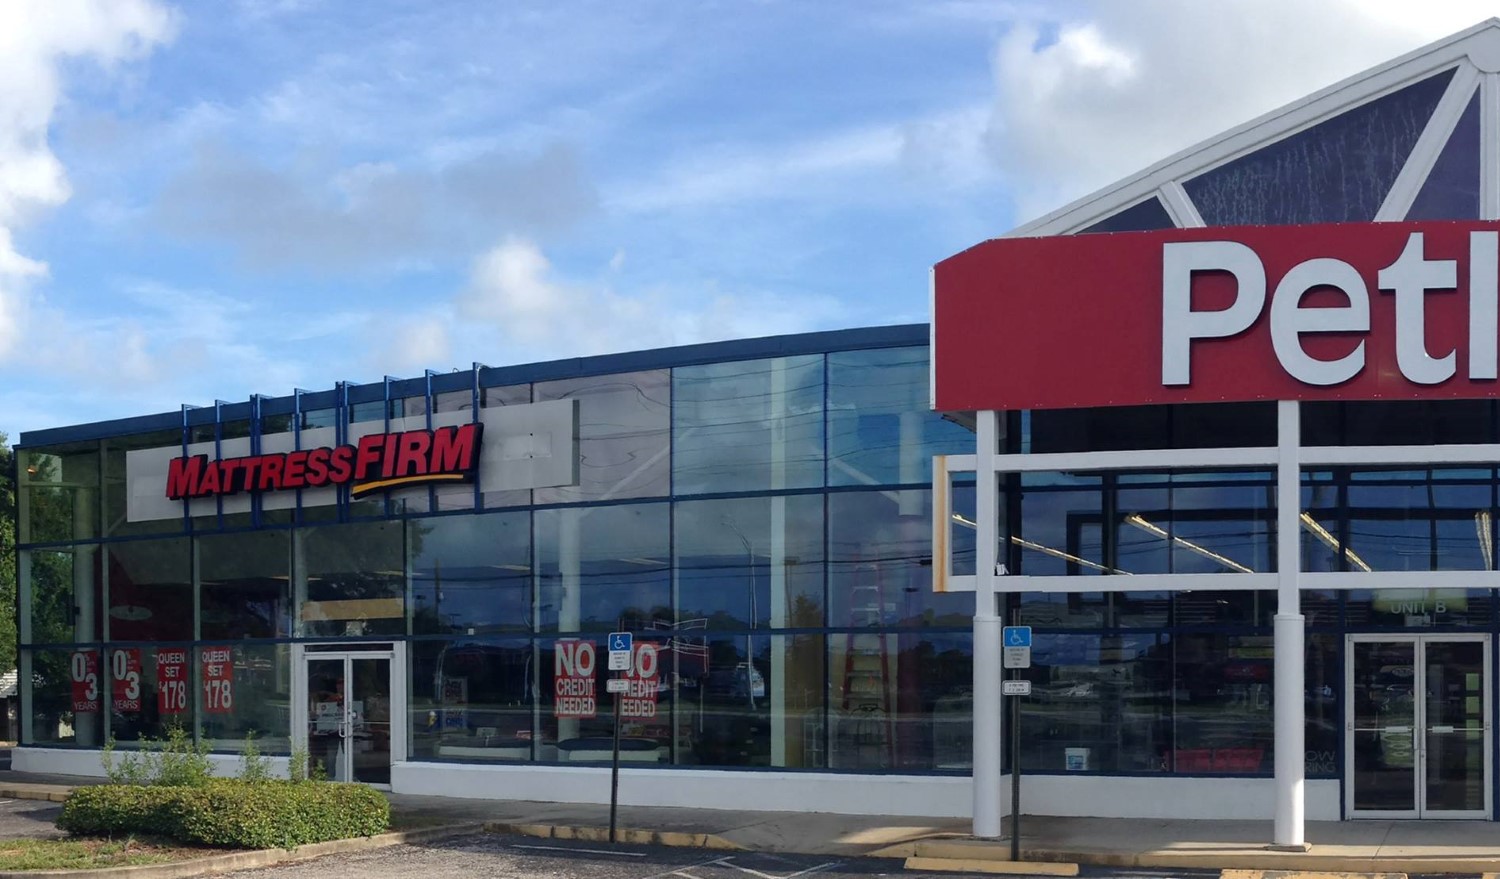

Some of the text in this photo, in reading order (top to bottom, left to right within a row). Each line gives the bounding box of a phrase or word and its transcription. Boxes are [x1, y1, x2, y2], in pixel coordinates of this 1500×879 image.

[354, 423, 481, 480] FIRM
[1390, 600, 1446, 614] UNIT B
[158, 653, 185, 664] QUEEN
[202, 650, 230, 662] QUEEN
[555, 643, 595, 676] NO
[165, 667, 180, 678] SET
[207, 665, 223, 676] SET
[85, 673, 98, 700] 3
[125, 671, 140, 699] 3
[556, 679, 595, 696] CREDIT
[74, 701, 97, 711] YEARS
[113, 700, 138, 709] YEARS
[555, 698, 595, 715] NEEDED
[622, 700, 656, 718] EEDED
[1305, 750, 1336, 762] OW
[1305, 761, 1336, 773] RING
